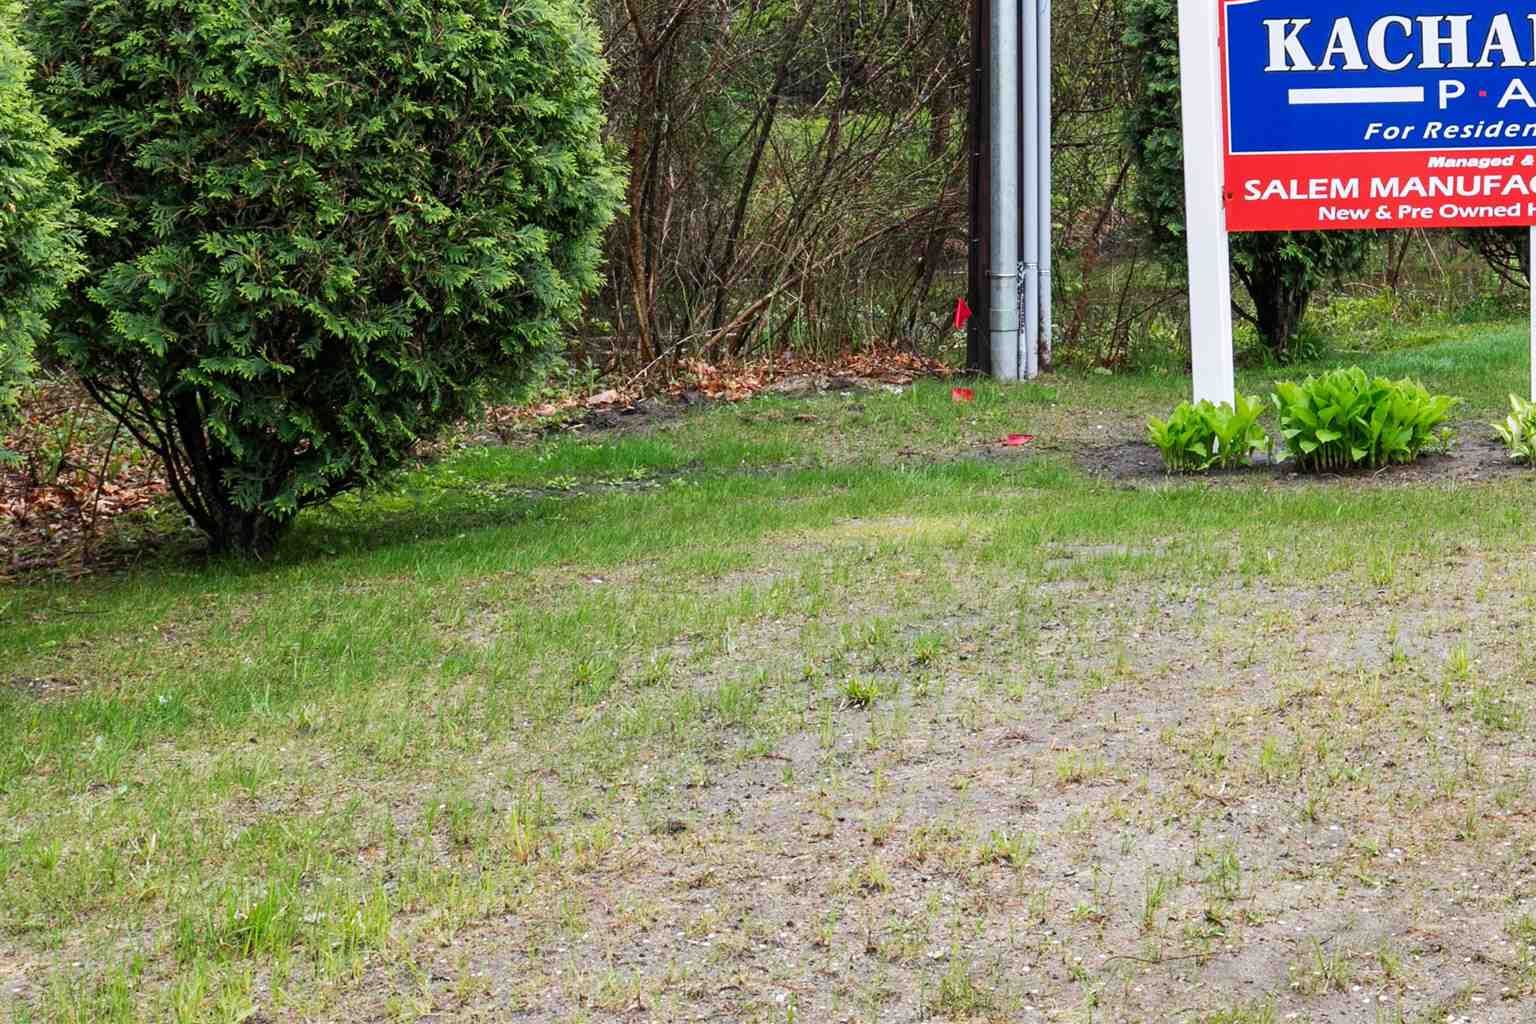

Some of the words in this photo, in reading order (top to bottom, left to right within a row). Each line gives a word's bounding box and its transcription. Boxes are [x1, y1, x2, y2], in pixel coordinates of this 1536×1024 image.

[1364, 122, 1415, 140] For
[1427, 154, 1515, 169] Managed
[1520, 154, 1535, 167] &
[1244, 177, 1360, 201] SALEM
[1318, 206, 1371, 221] New
[1375, 204, 1393, 220] &
[1397, 204, 1434, 220] Pre
[1438, 202, 1521, 219] Owned
